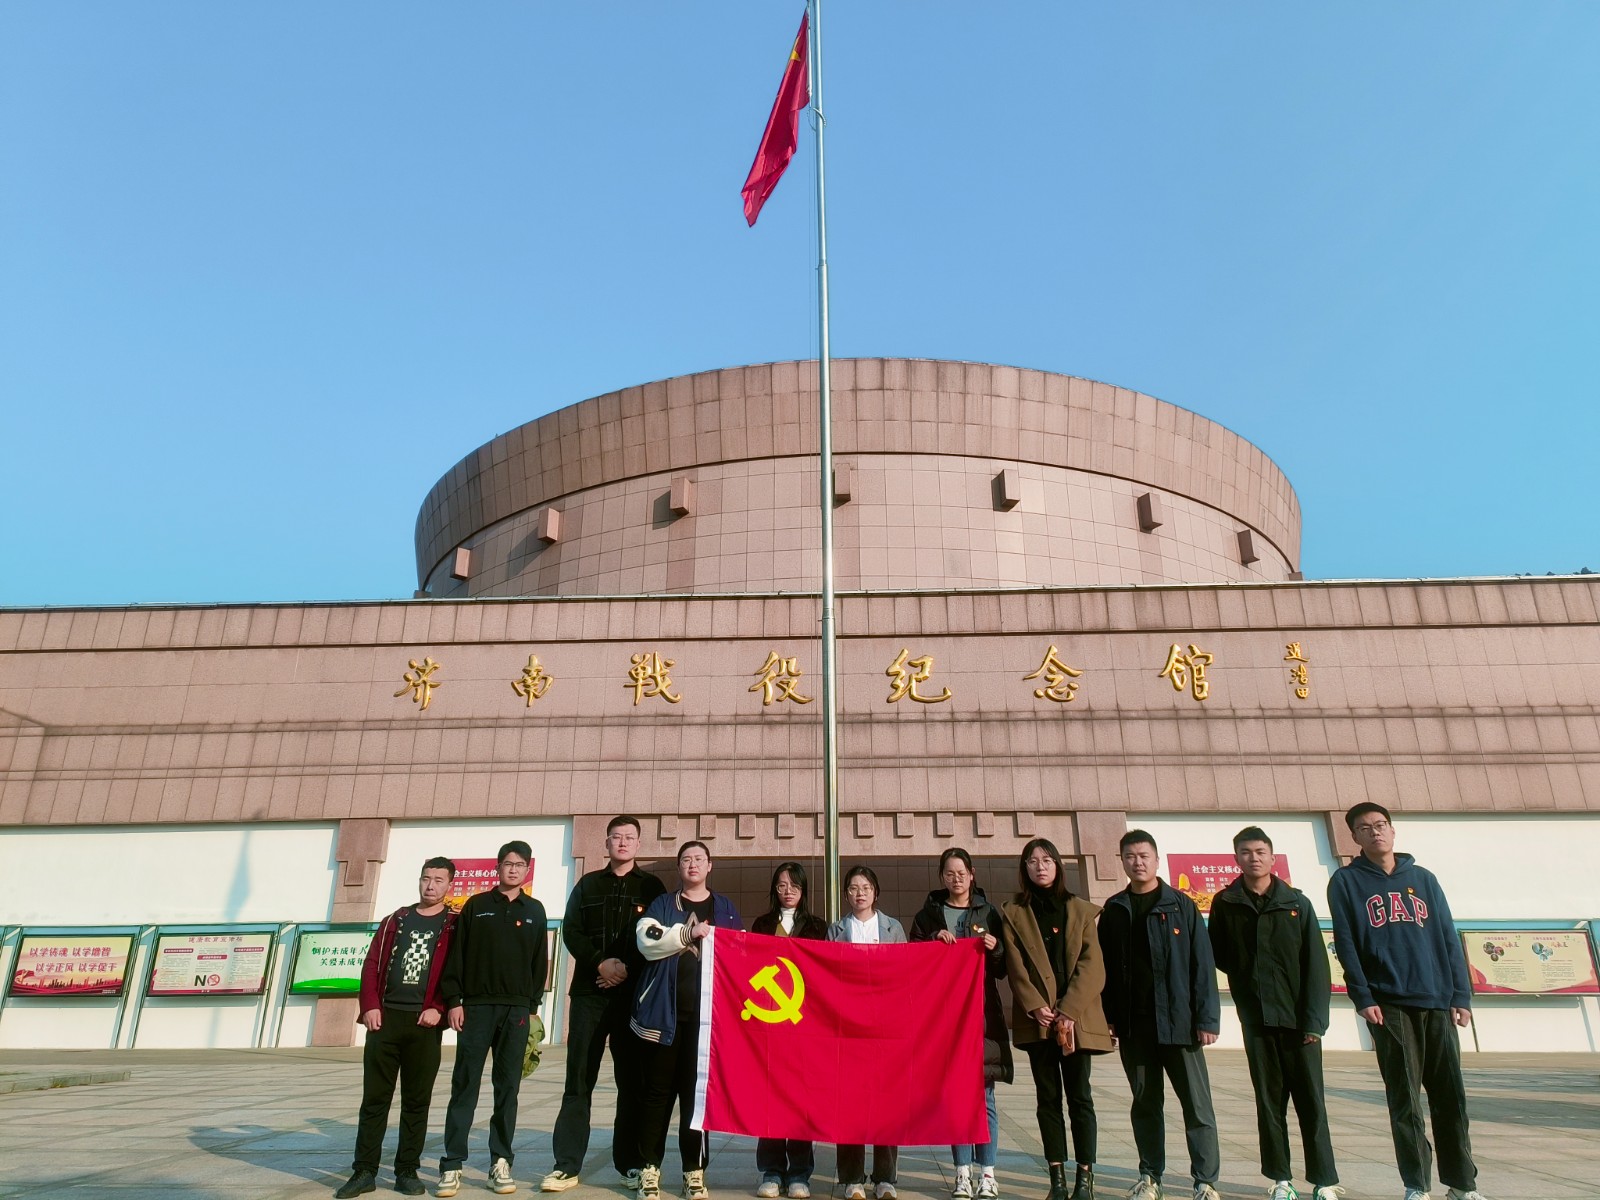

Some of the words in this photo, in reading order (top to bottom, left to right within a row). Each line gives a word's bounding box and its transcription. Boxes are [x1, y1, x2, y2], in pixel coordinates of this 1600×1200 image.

[1366, 892, 1428, 927] GAP
[29, 947, 68, 957] 以学铸魂
[72, 947, 111, 957] 以学增智
[35, 962, 74, 972] 以学正风
